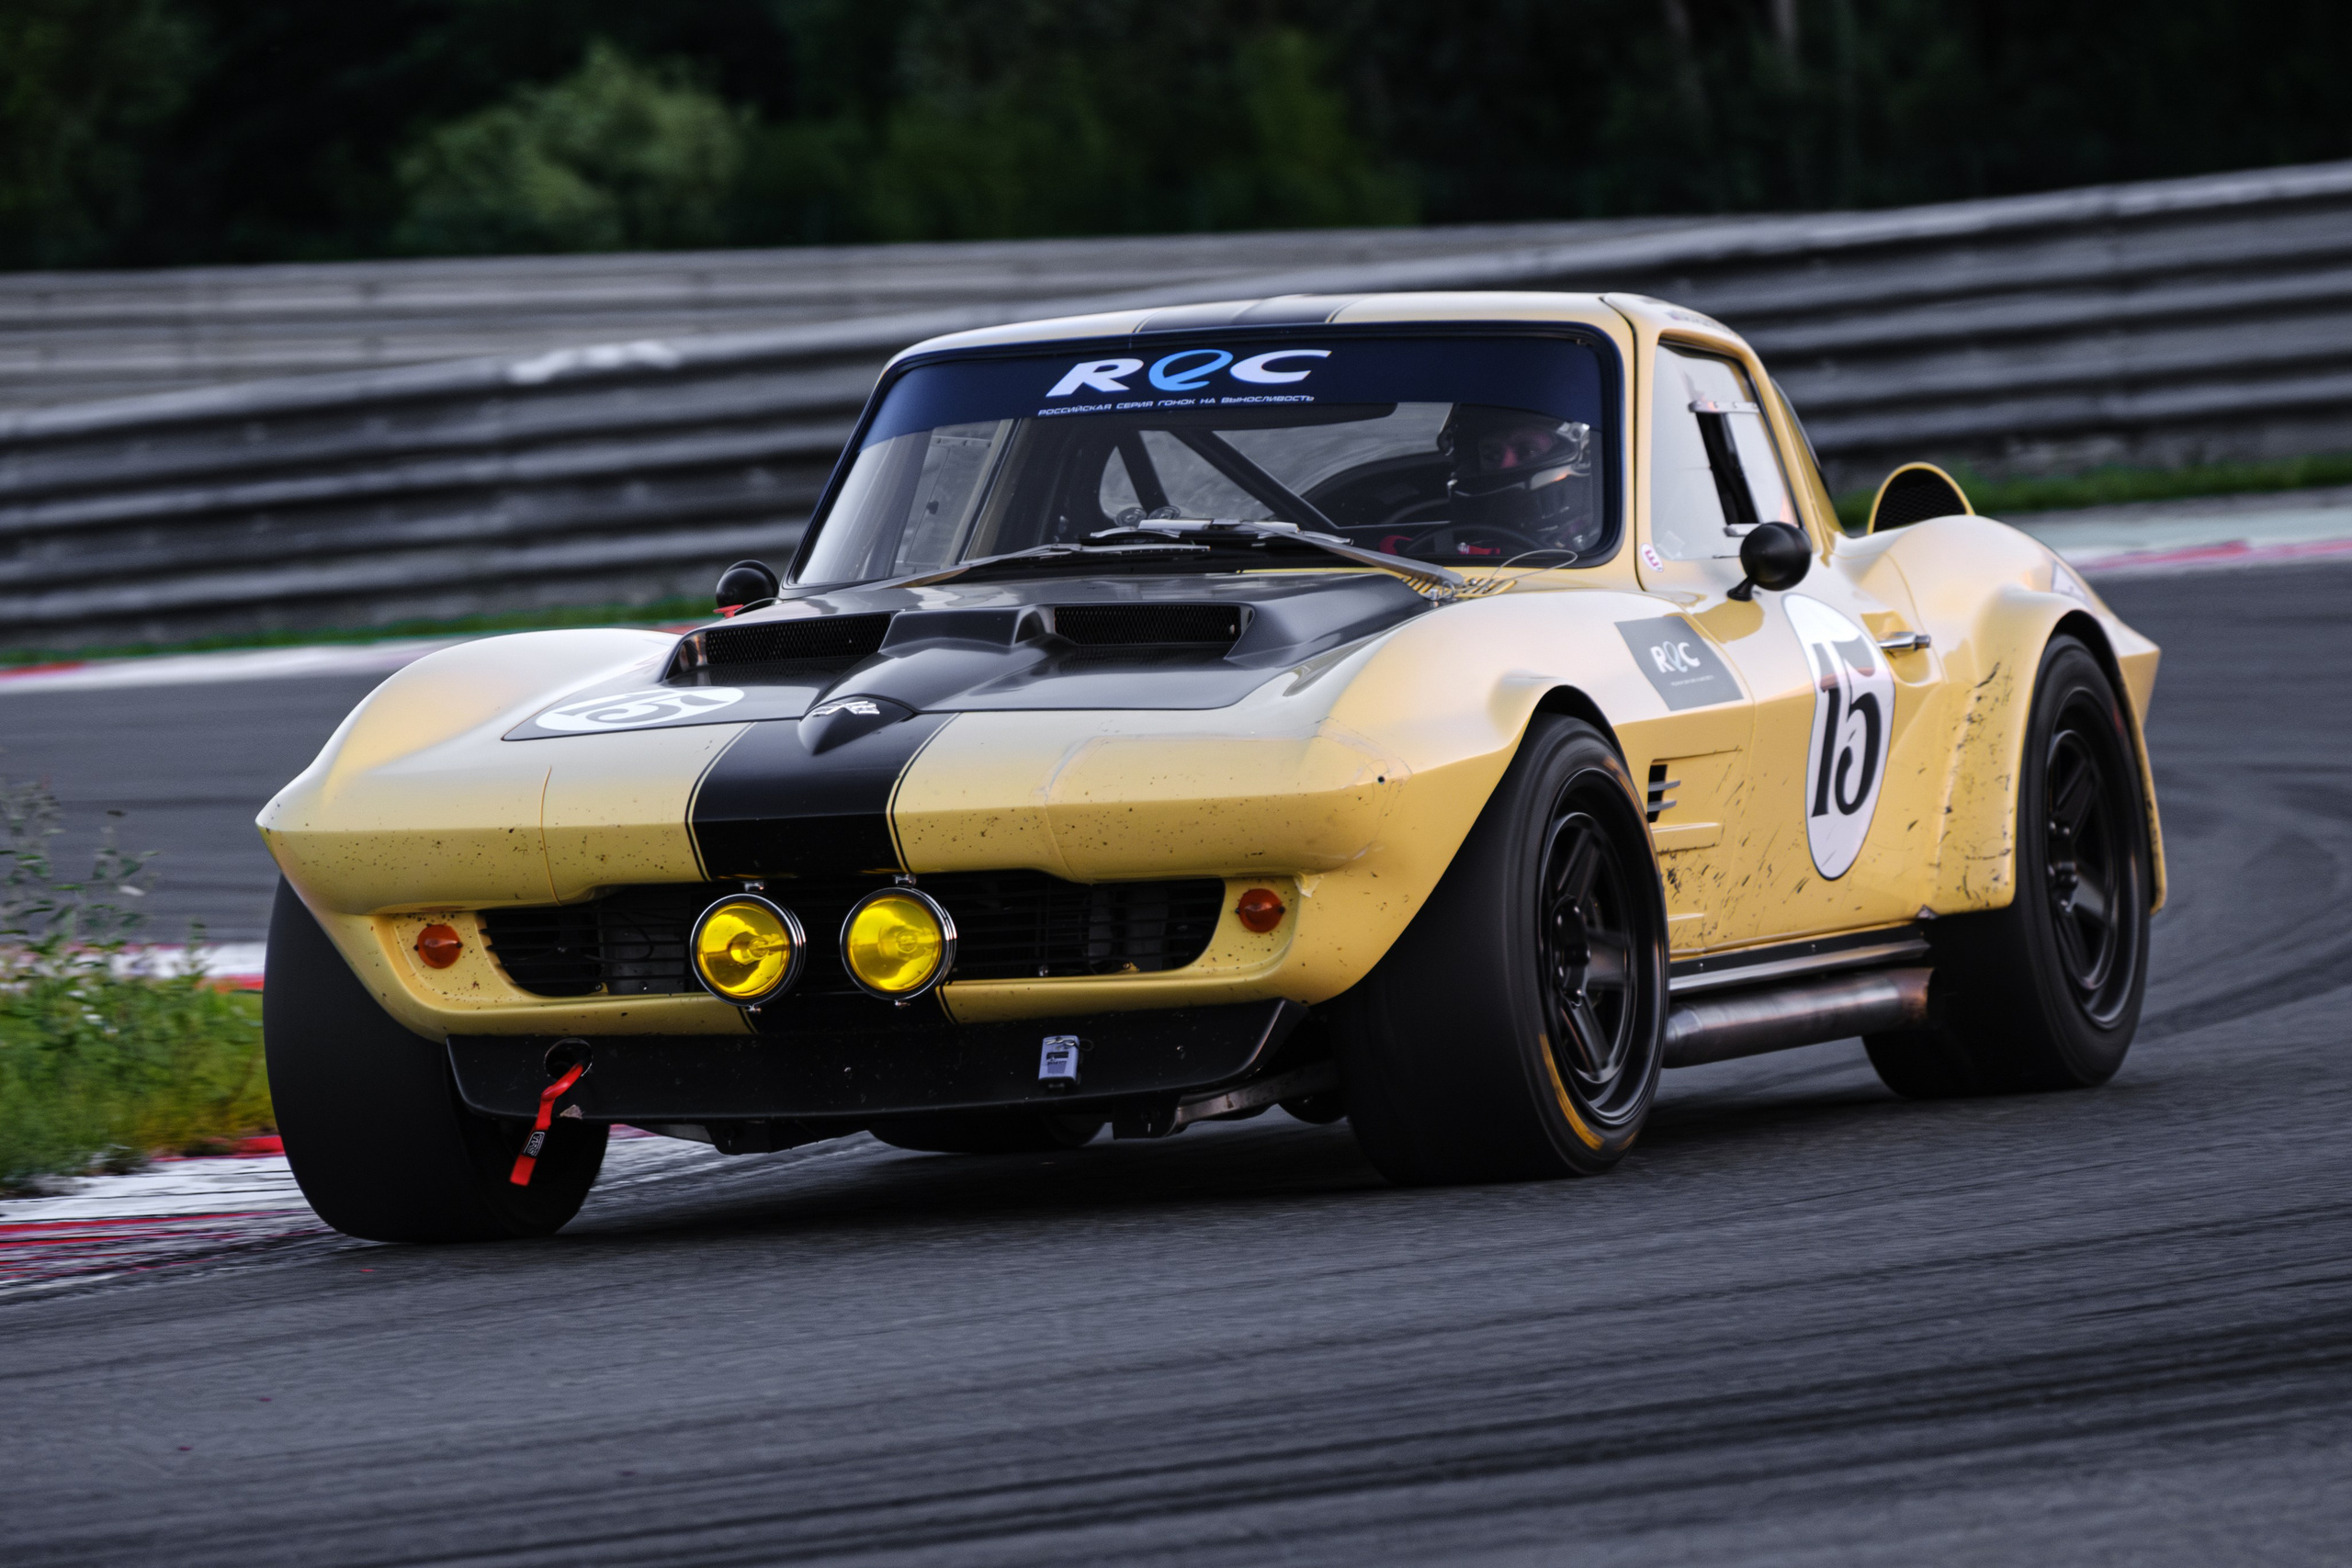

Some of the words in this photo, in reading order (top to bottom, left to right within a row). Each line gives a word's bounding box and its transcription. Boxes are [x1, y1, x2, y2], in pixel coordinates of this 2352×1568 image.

[1038, 404, 1112, 416] РОССИЙСКАЯ
[1116, 400, 1154, 410] СЕРИЯ
[1221, 395, 1315, 403] ВЫНОСЛИВОСТЬ
[554, 691, 729, 723] 15
[1811, 635, 1882, 818] 15
